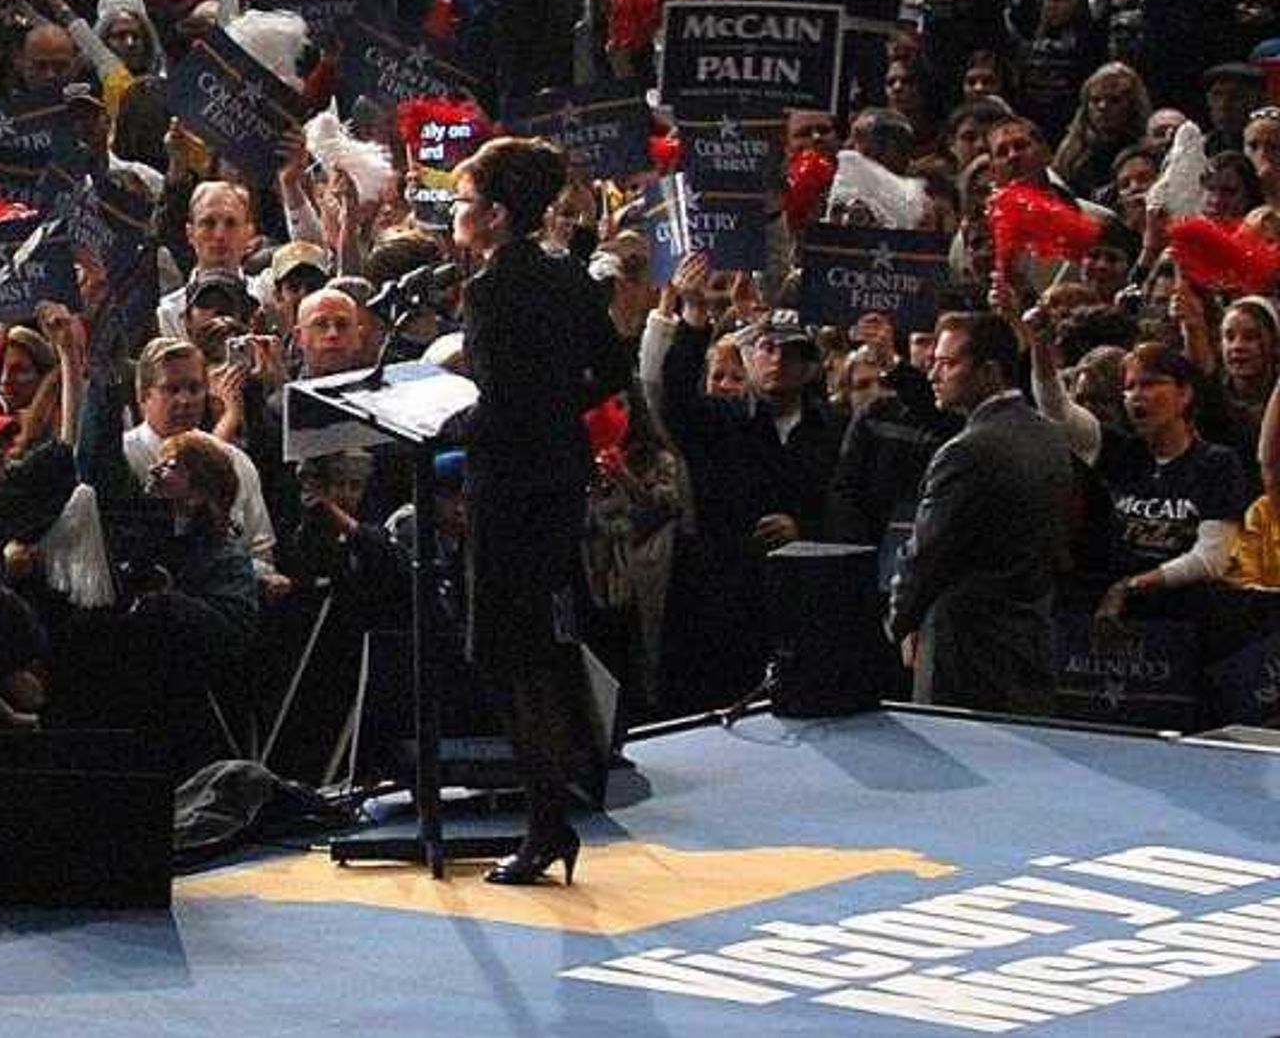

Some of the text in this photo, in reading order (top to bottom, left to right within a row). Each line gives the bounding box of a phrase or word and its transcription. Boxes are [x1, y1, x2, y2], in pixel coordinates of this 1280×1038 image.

[681, 14, 824, 43] McCAIN
[695, 55, 802, 85] PALIN
[447, 124, 471, 137] on
[693, 137, 771, 158] COUNTRY
[827, 267, 921, 293] COUNTRY
[552, 845, 1280, 1005] Victory in
